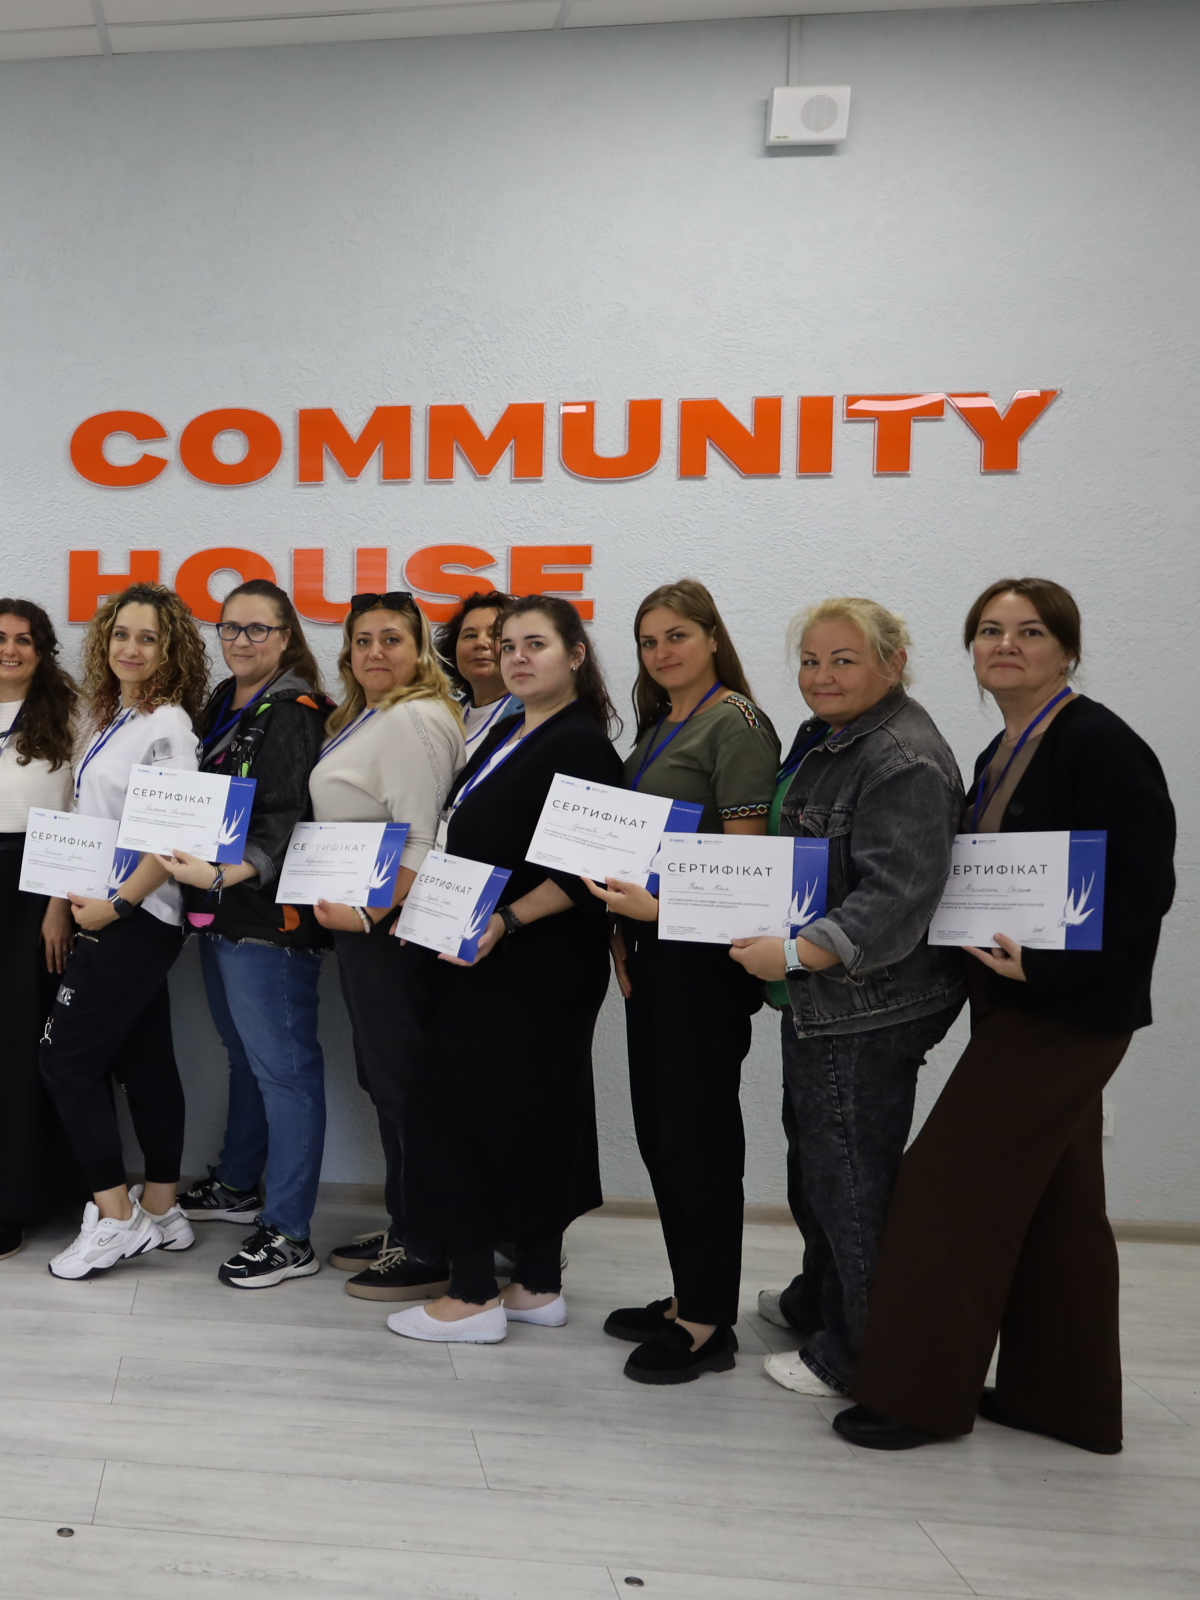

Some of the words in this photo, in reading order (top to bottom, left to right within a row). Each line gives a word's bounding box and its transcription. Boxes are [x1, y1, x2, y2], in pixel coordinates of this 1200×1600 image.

[68, 388, 1062, 488] COMMUNITY
[67, 543, 595, 625] HOUSE
[132, 787, 213, 805] СЕРТИФІКАТ
[552, 799, 648, 829] СЕРТИФІКАТ
[30, 830, 103, 850] СЕРТИФІКАТ
[292, 842, 367, 852] СЕРТИФІКАТ
[667, 862, 773, 877] СЕРТИФІКАТ
[953, 864, 1048, 875] ЕРТИФІКАТ
[418, 873, 473, 896] СЕРТИФІКАТ
